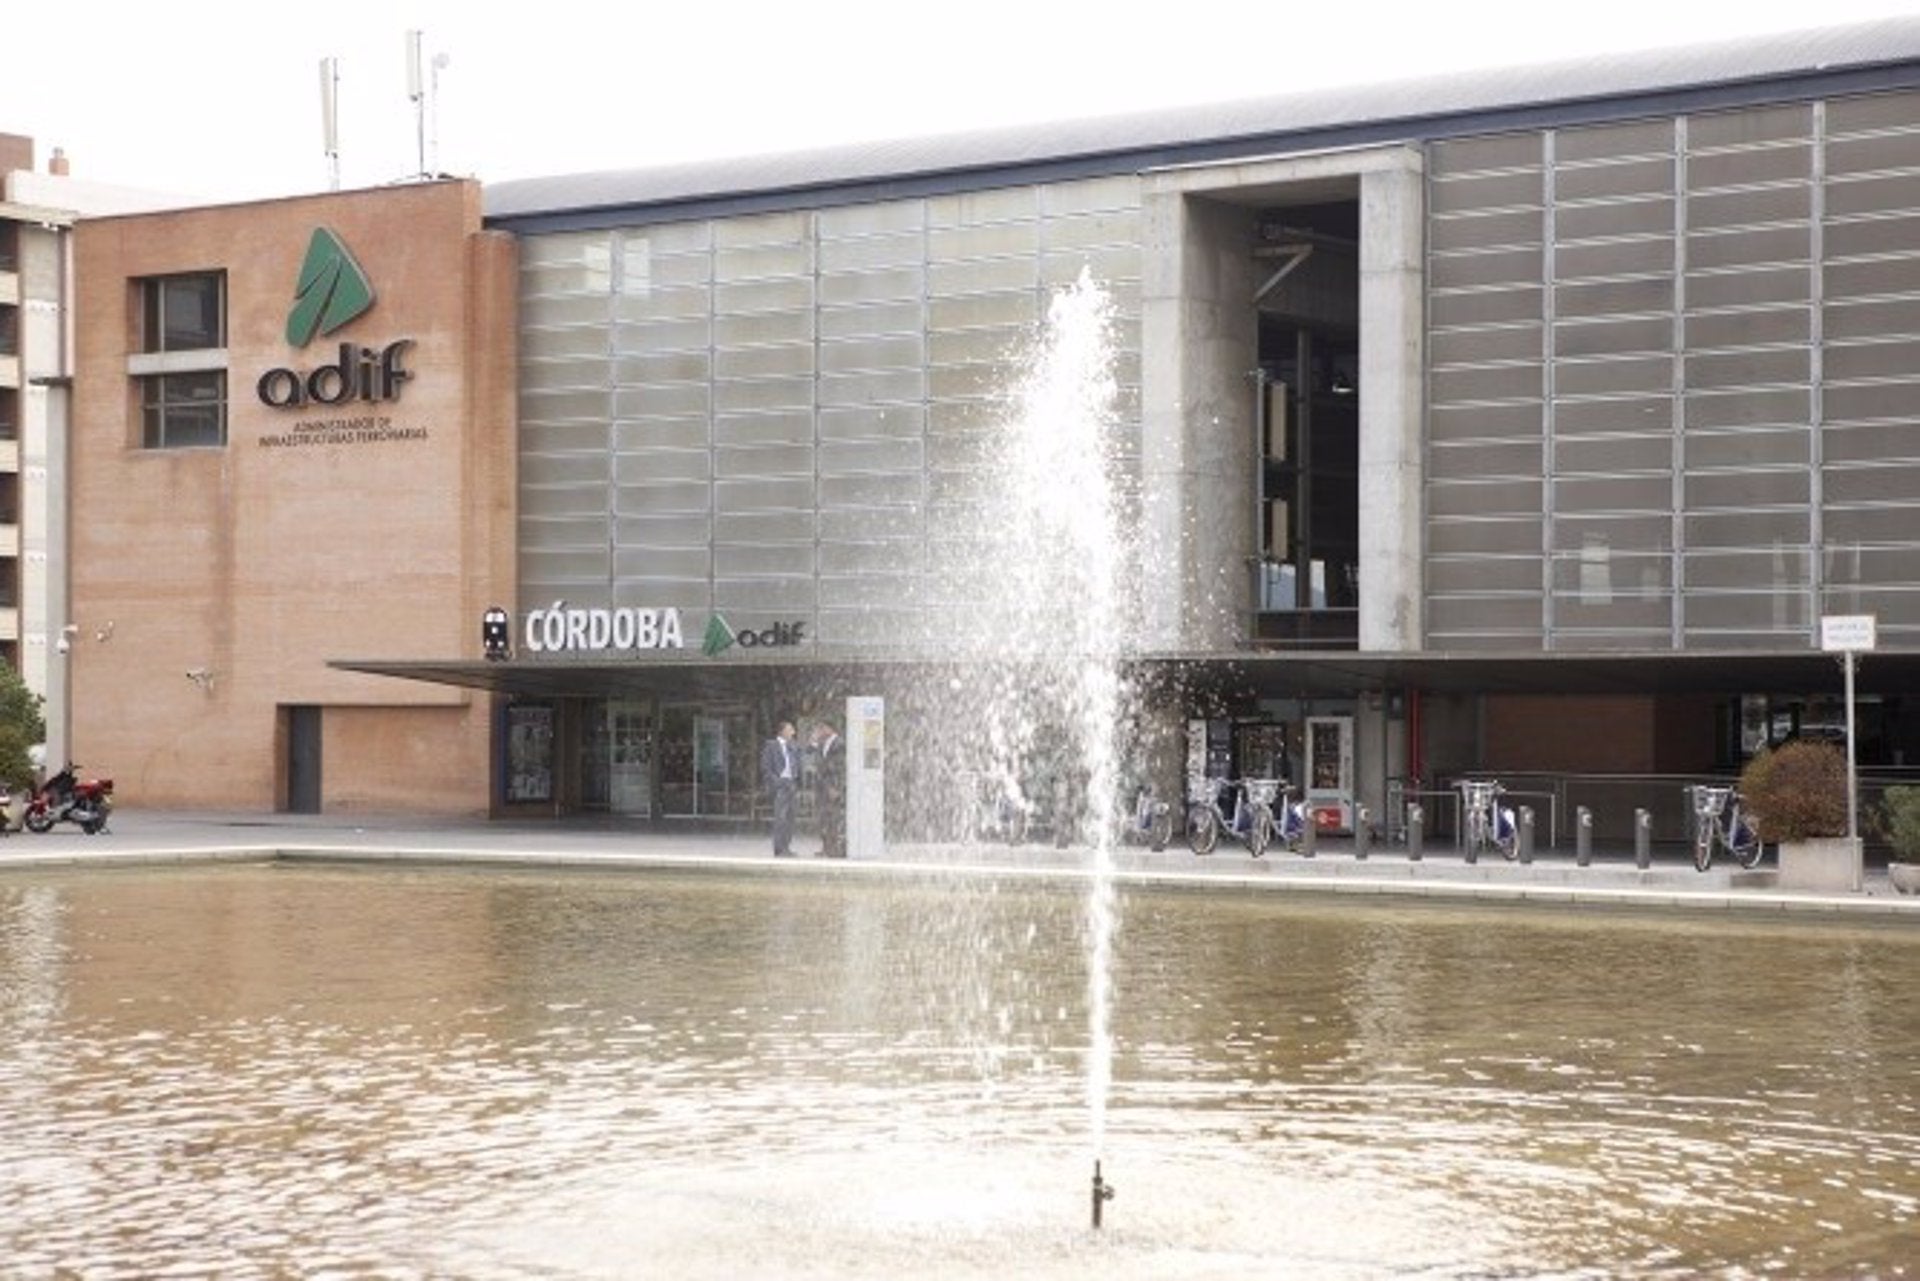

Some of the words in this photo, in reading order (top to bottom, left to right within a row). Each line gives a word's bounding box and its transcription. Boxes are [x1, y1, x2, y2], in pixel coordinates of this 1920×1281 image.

[257, 339, 417, 408] adif
[526, 601, 683, 651] CÓRDOBA
[737, 621, 807, 648] adif
